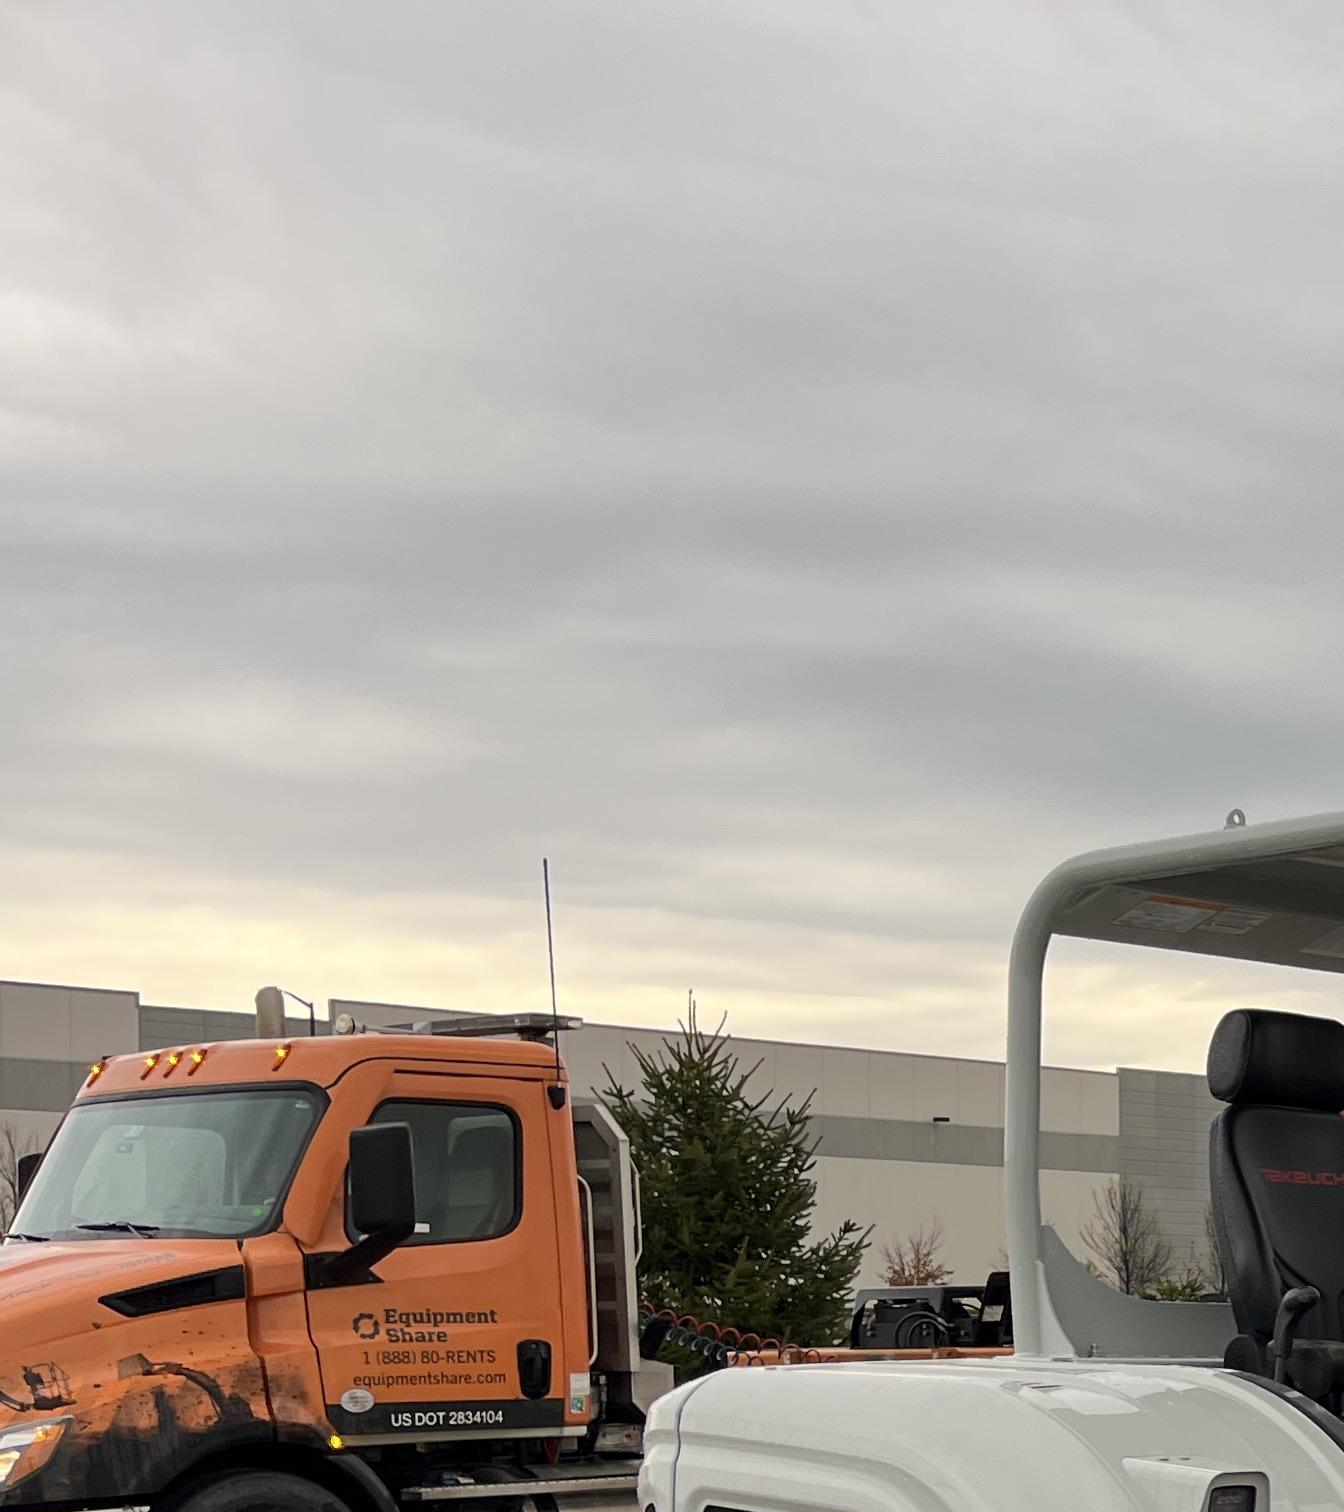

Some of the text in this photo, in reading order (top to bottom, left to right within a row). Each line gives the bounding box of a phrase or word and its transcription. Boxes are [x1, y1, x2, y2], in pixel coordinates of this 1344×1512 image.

[383, 1308, 498, 1328] Equipment
[386, 1327, 448, 1344] Share
[363, 1349, 496, 1365] 1 (888) 80-RENTS
[353, 1370, 507, 1389] equipmentshare.com
[390, 1409, 504, 1427] US DOT 2834104
